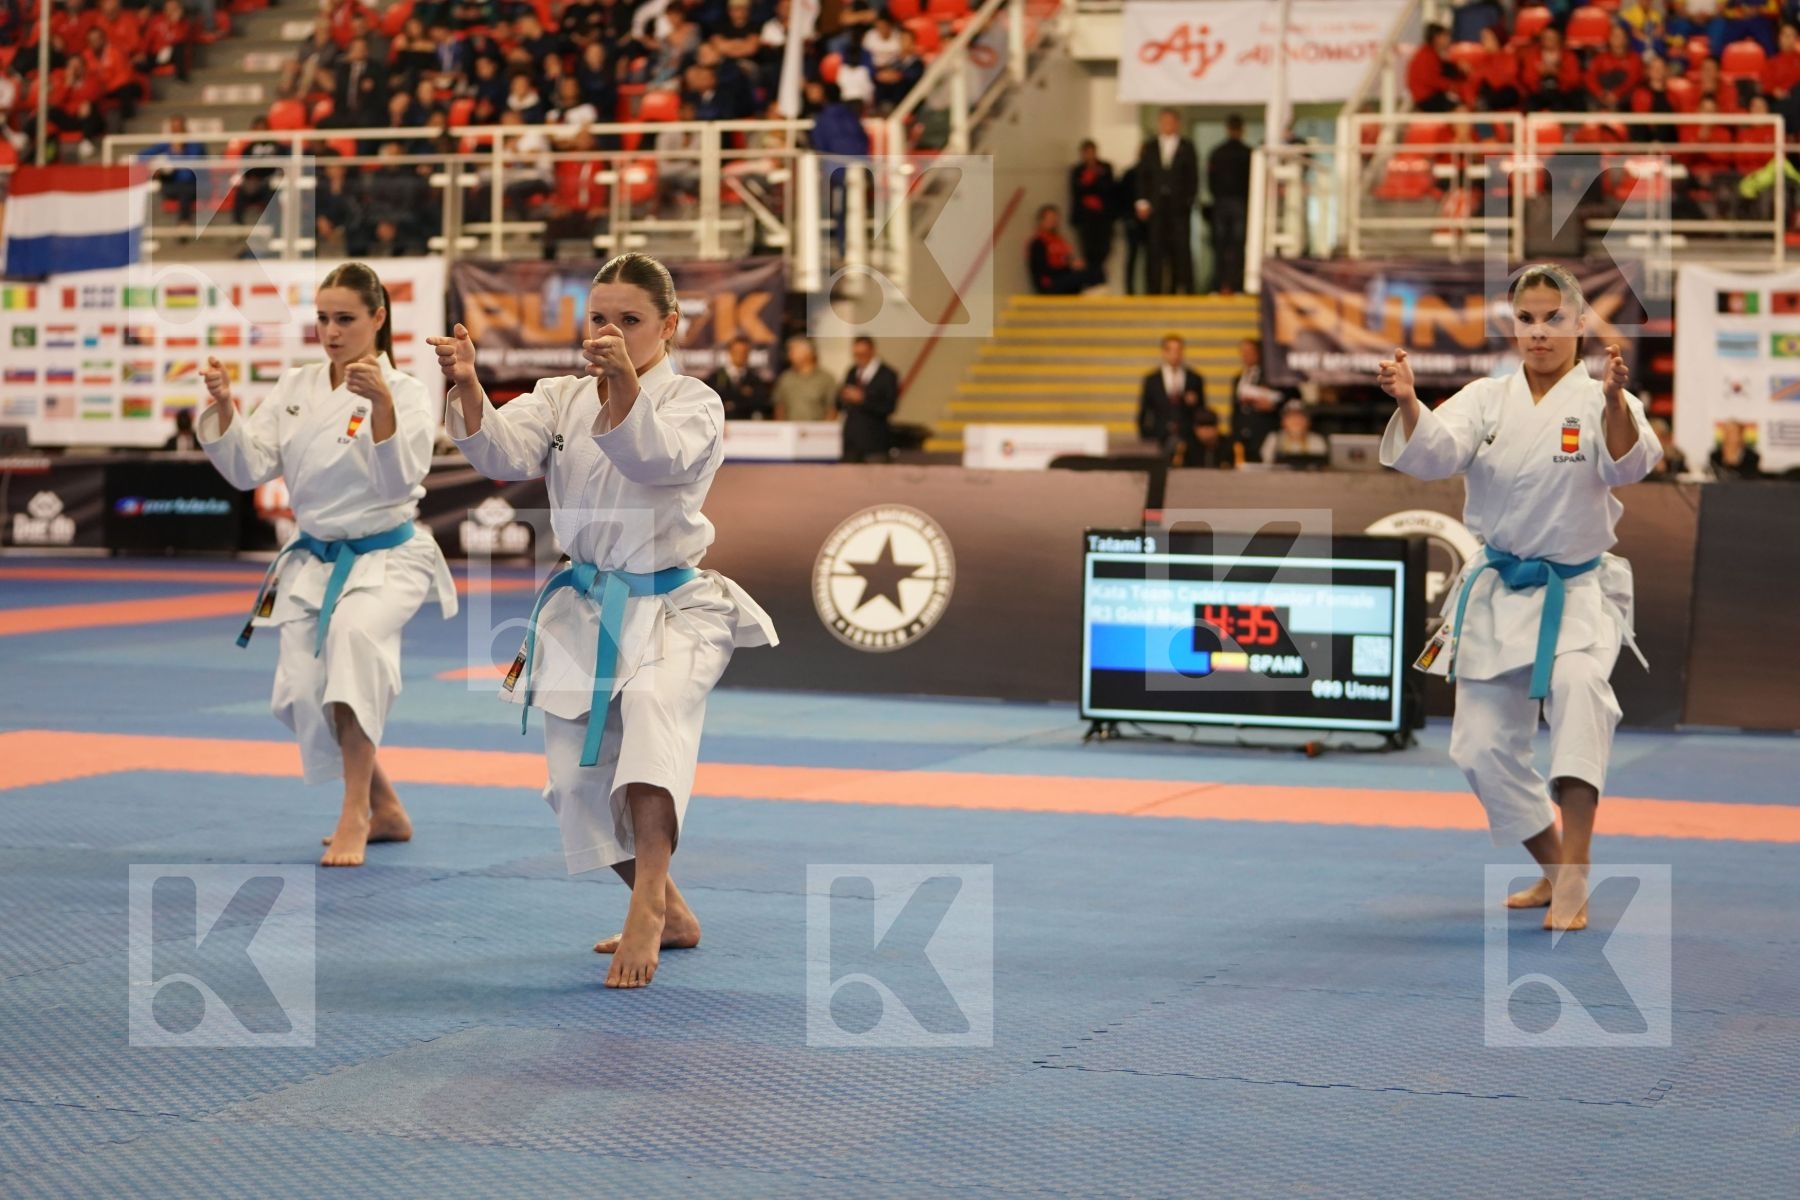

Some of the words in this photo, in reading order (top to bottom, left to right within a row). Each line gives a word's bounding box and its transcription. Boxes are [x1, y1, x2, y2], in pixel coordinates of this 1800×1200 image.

[1087, 535, 1143, 552] Tatami
[1144, 537, 1156, 554] 3
[1204, 604, 1279, 645] 4:35
[1249, 655, 1302, 674] SPAIN
[1345, 680, 1390, 700] Unsu
